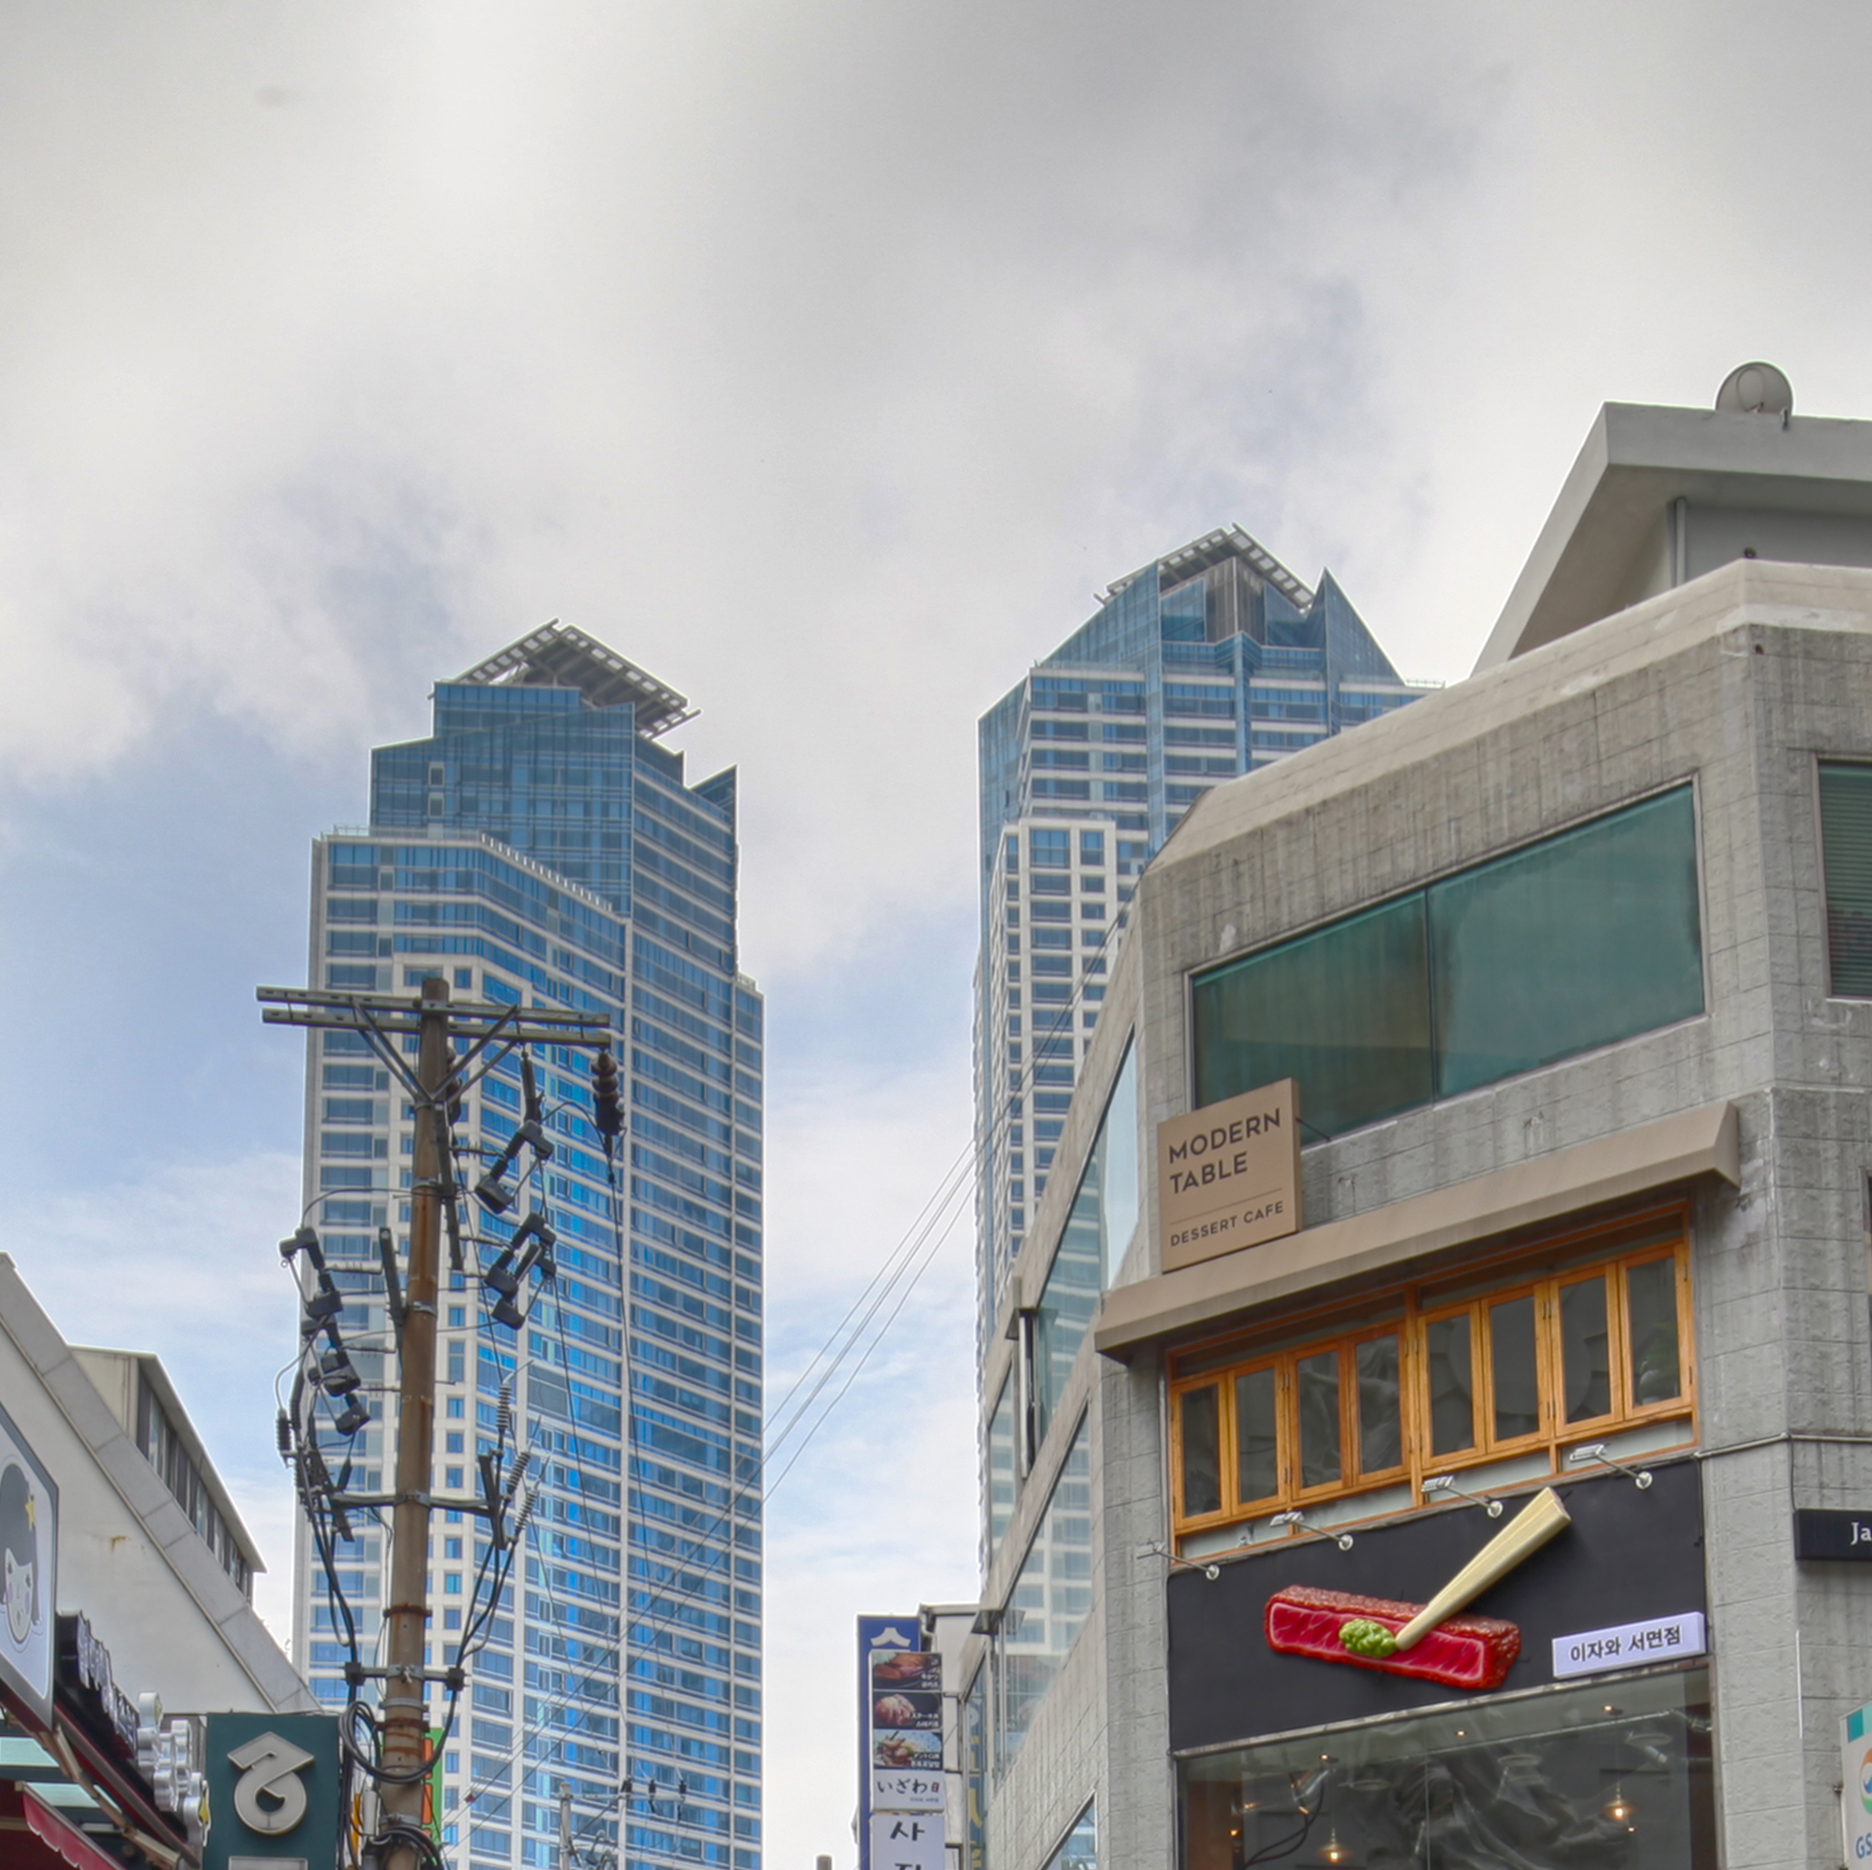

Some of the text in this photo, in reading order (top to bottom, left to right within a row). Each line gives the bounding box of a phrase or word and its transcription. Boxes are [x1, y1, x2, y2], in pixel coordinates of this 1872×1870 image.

[1167, 1106, 1283, 1166] MODERN
[1169, 1149, 1250, 1197] TABLE
[1169, 1199, 1285, 1248] DESSERT CAFE
[1569, 1624, 1682, 1665] 이자와 서면점
[877, 1778, 928, 1794] いざわ
